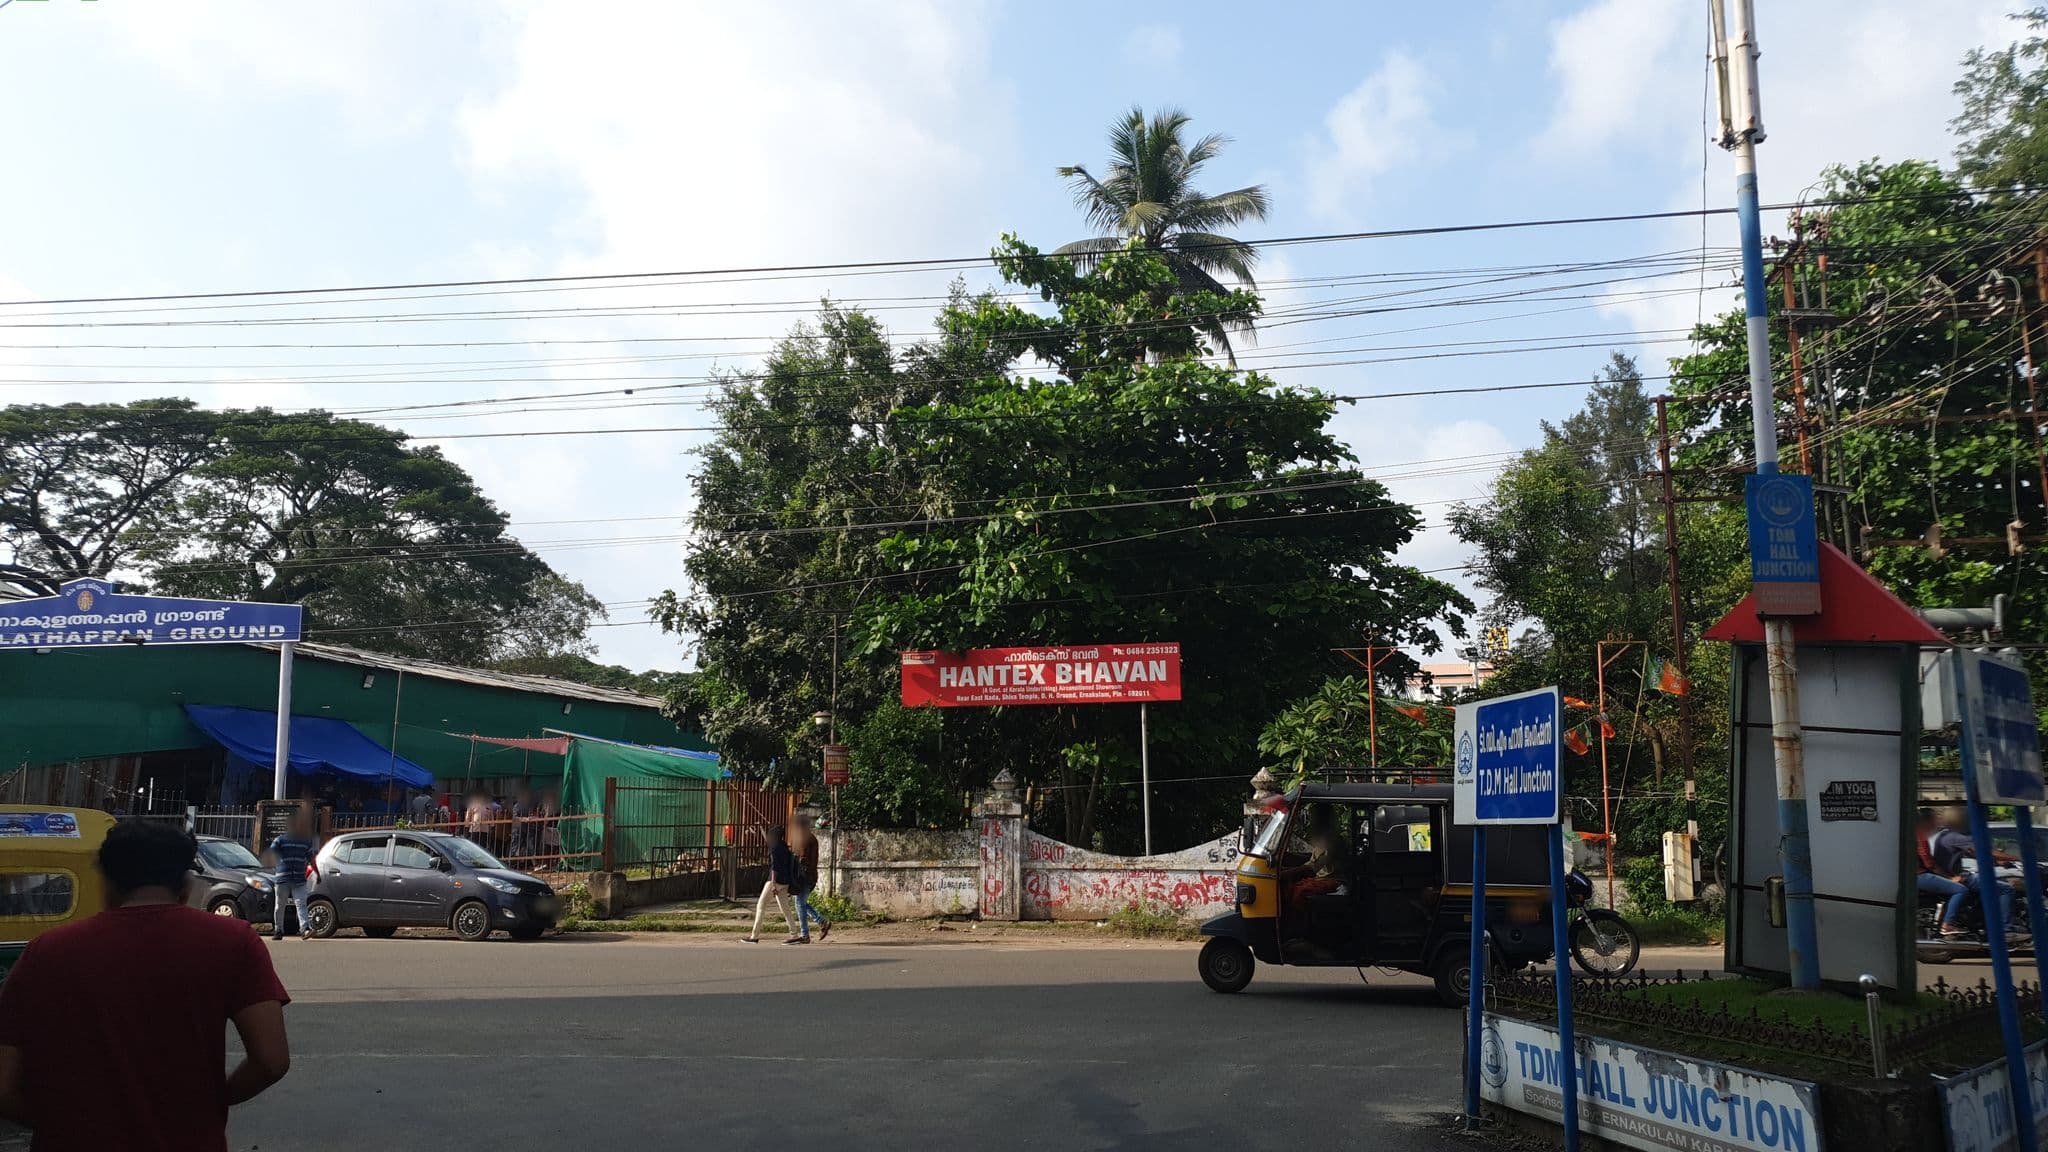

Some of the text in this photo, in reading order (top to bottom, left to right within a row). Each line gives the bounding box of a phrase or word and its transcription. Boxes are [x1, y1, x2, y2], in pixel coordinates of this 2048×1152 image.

[1769, 543, 1800, 559] HALL
[1756, 561, 1816, 576] JUNCTION
[170, 625, 286, 641] GROUND
[1113, 646, 1178, 656] Ph: 0484 2351323
[940, 660, 1167, 688] HANTEX BHAVAN
[1480, 763, 1552, 796] T.D.M Hall Junction
[1846, 783, 1875, 794] YOGA
[1515, 1041, 1806, 1152] TDM HALL JUNCTION
[1602, 1111, 1687, 1148] ERNAKULAM
